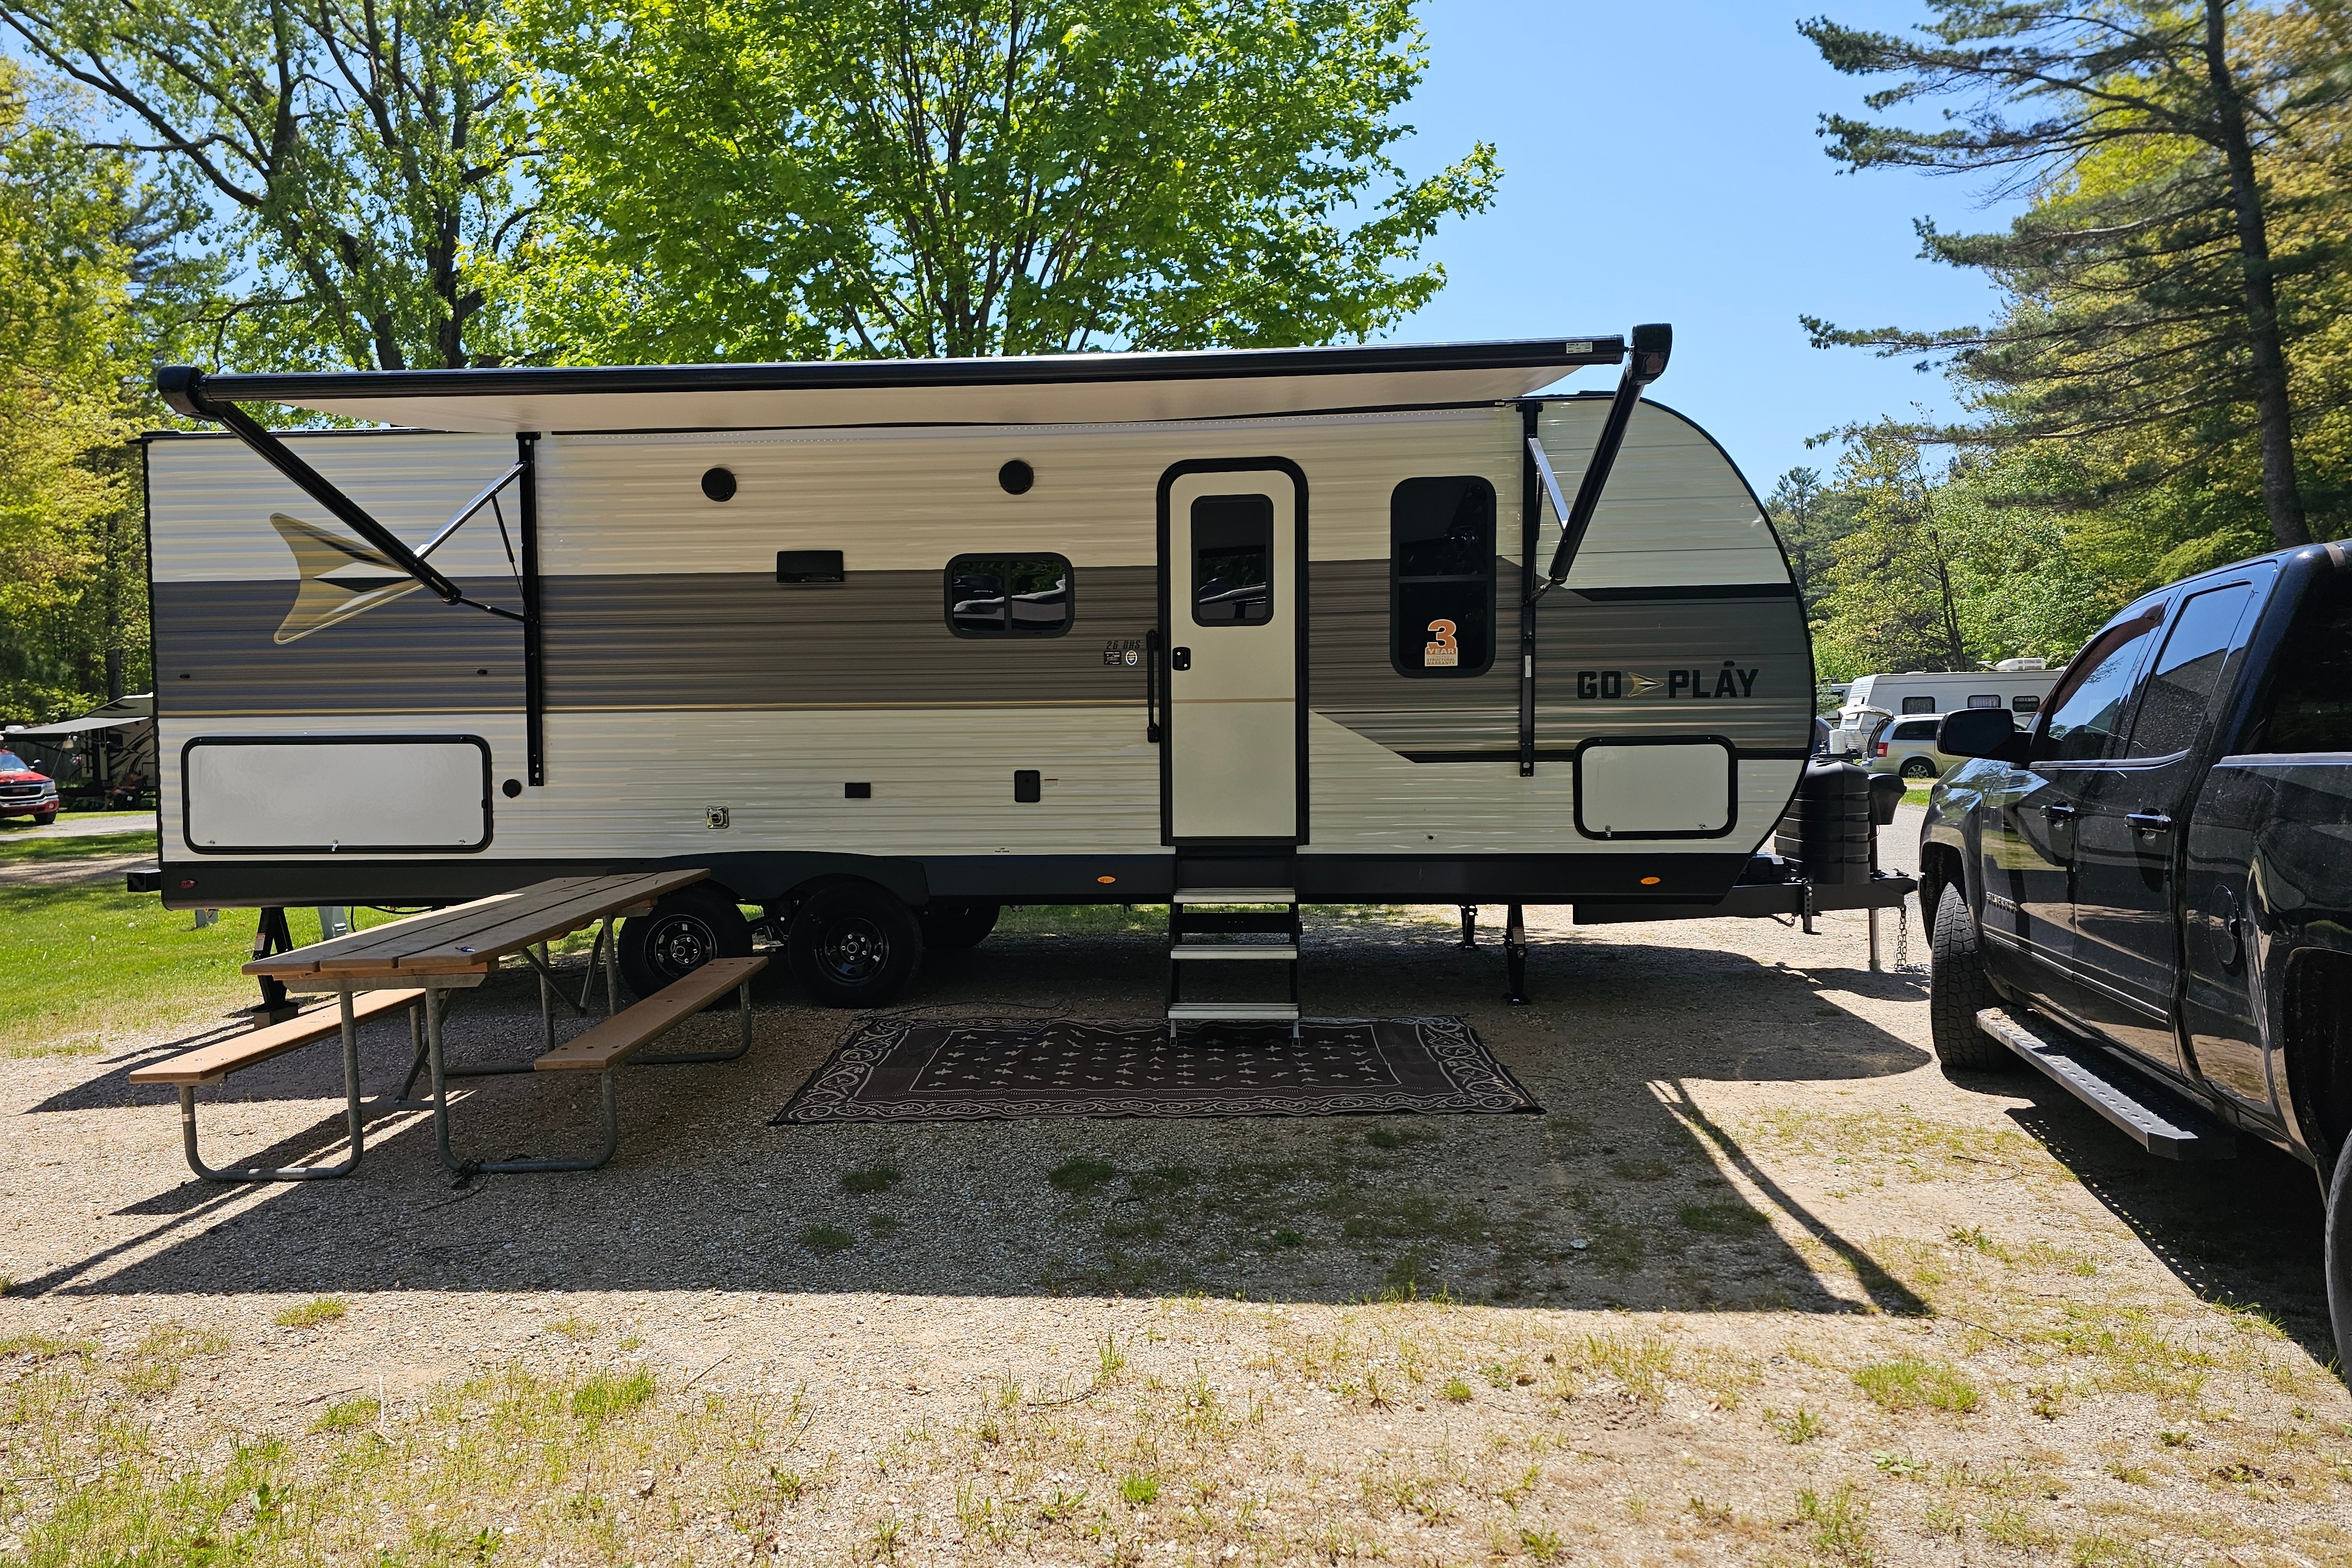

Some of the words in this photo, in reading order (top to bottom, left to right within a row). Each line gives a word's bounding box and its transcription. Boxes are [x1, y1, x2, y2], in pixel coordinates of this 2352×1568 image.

[1106, 640, 1118, 649] 26
[1123, 640, 1141, 649] BHS
[1427, 619, 1456, 648] 3
[1577, 671, 1622, 699] GO
